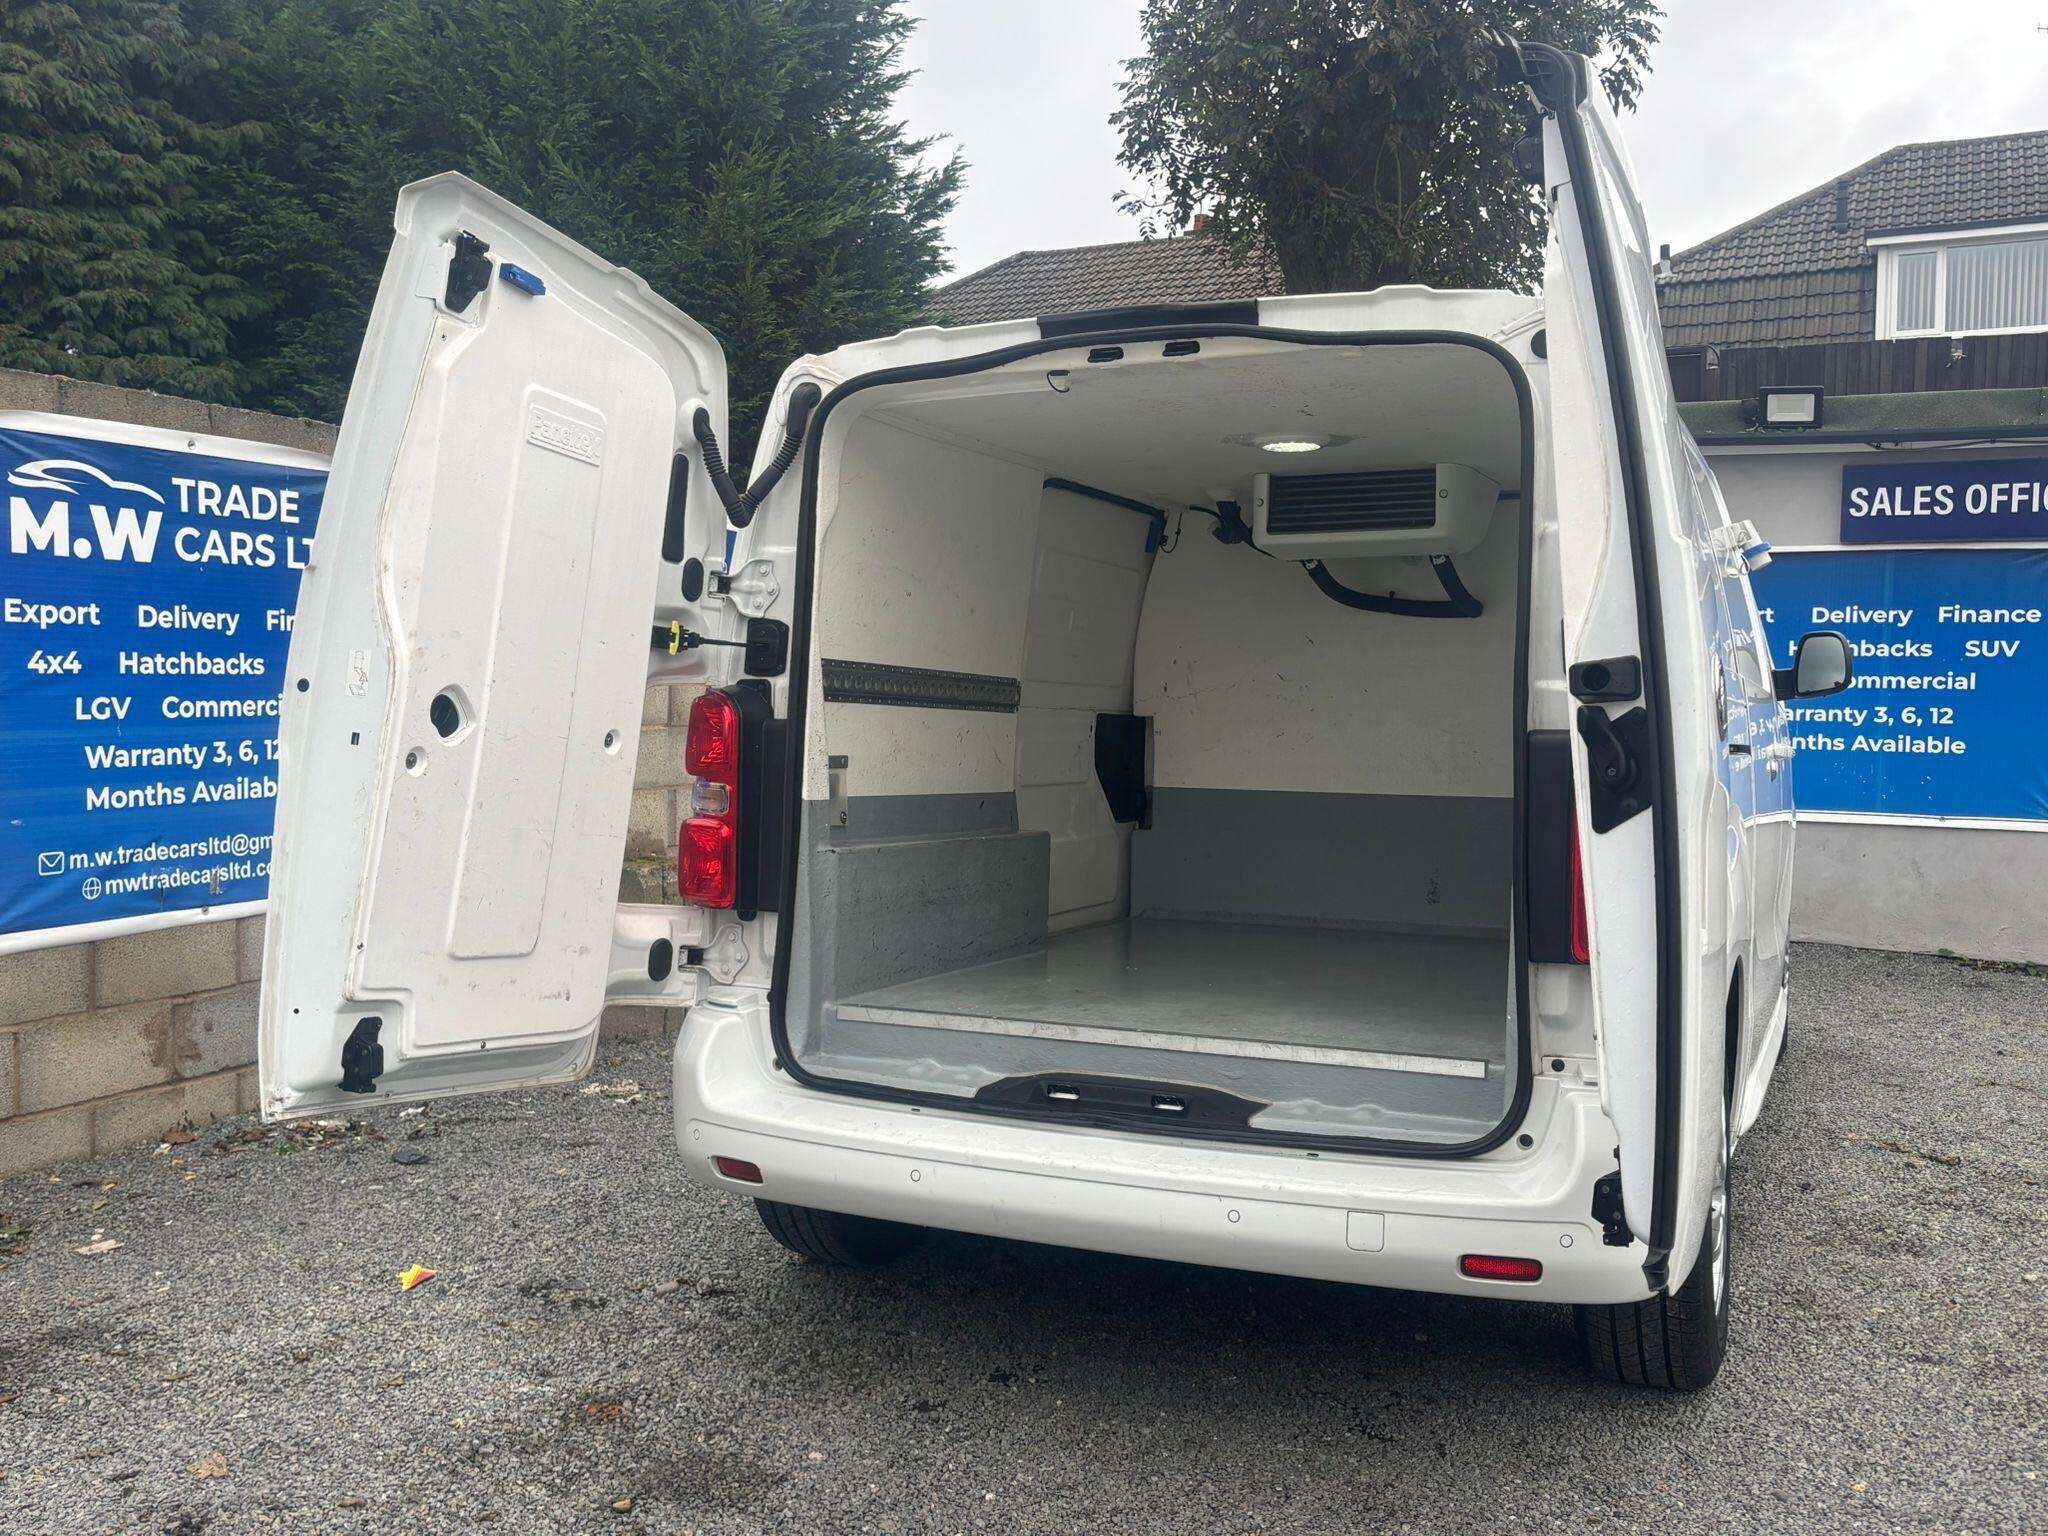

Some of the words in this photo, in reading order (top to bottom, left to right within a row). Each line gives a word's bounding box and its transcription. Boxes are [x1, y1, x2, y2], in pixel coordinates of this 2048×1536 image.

[172, 477, 299, 523] TRADE
[1849, 485, 1953, 517] SALES
[1966, 483, 2048, 514] OFFI
[10, 497, 164, 563] M.W
[175, 527, 276, 567] CARS
[5, 598, 100, 629] Export
[139, 605, 239, 635] Delivery
[1813, 606, 1913, 626] Delivery
[1939, 605, 2041, 622] Finance
[28, 651, 81, 673] 4x4
[120, 652, 265, 674] Hatchbacks
[1966, 641, 2020, 657] SUV
[76, 697, 131, 720] LGV
[1874, 707, 1893, 725] 3,
[1902, 707, 1922, 726] 6,
[1930, 708, 1953, 724] 12
[85, 744, 207, 769] Warranty
[213, 742, 232, 766] 3,
[239, 740, 258, 764] 6,
[1851, 735, 1965, 754] Available
[87, 783, 185, 810] Months
